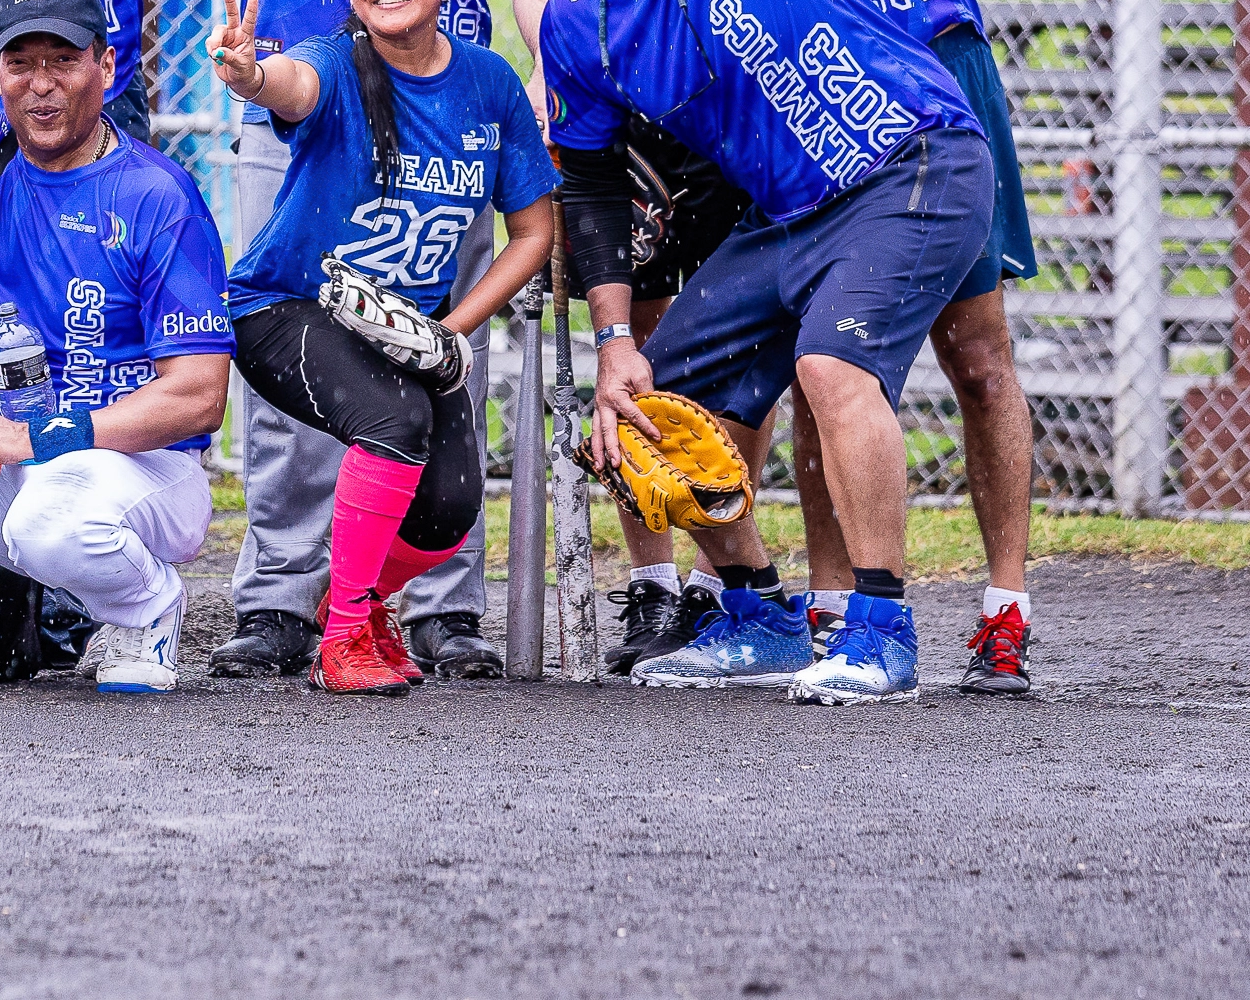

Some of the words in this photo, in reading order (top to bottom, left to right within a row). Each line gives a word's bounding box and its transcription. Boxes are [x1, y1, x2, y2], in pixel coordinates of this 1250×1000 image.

[798, 22, 920, 155] 2023
[333, 196, 476, 287] 26
[162, 309, 231, 337] Bladex
